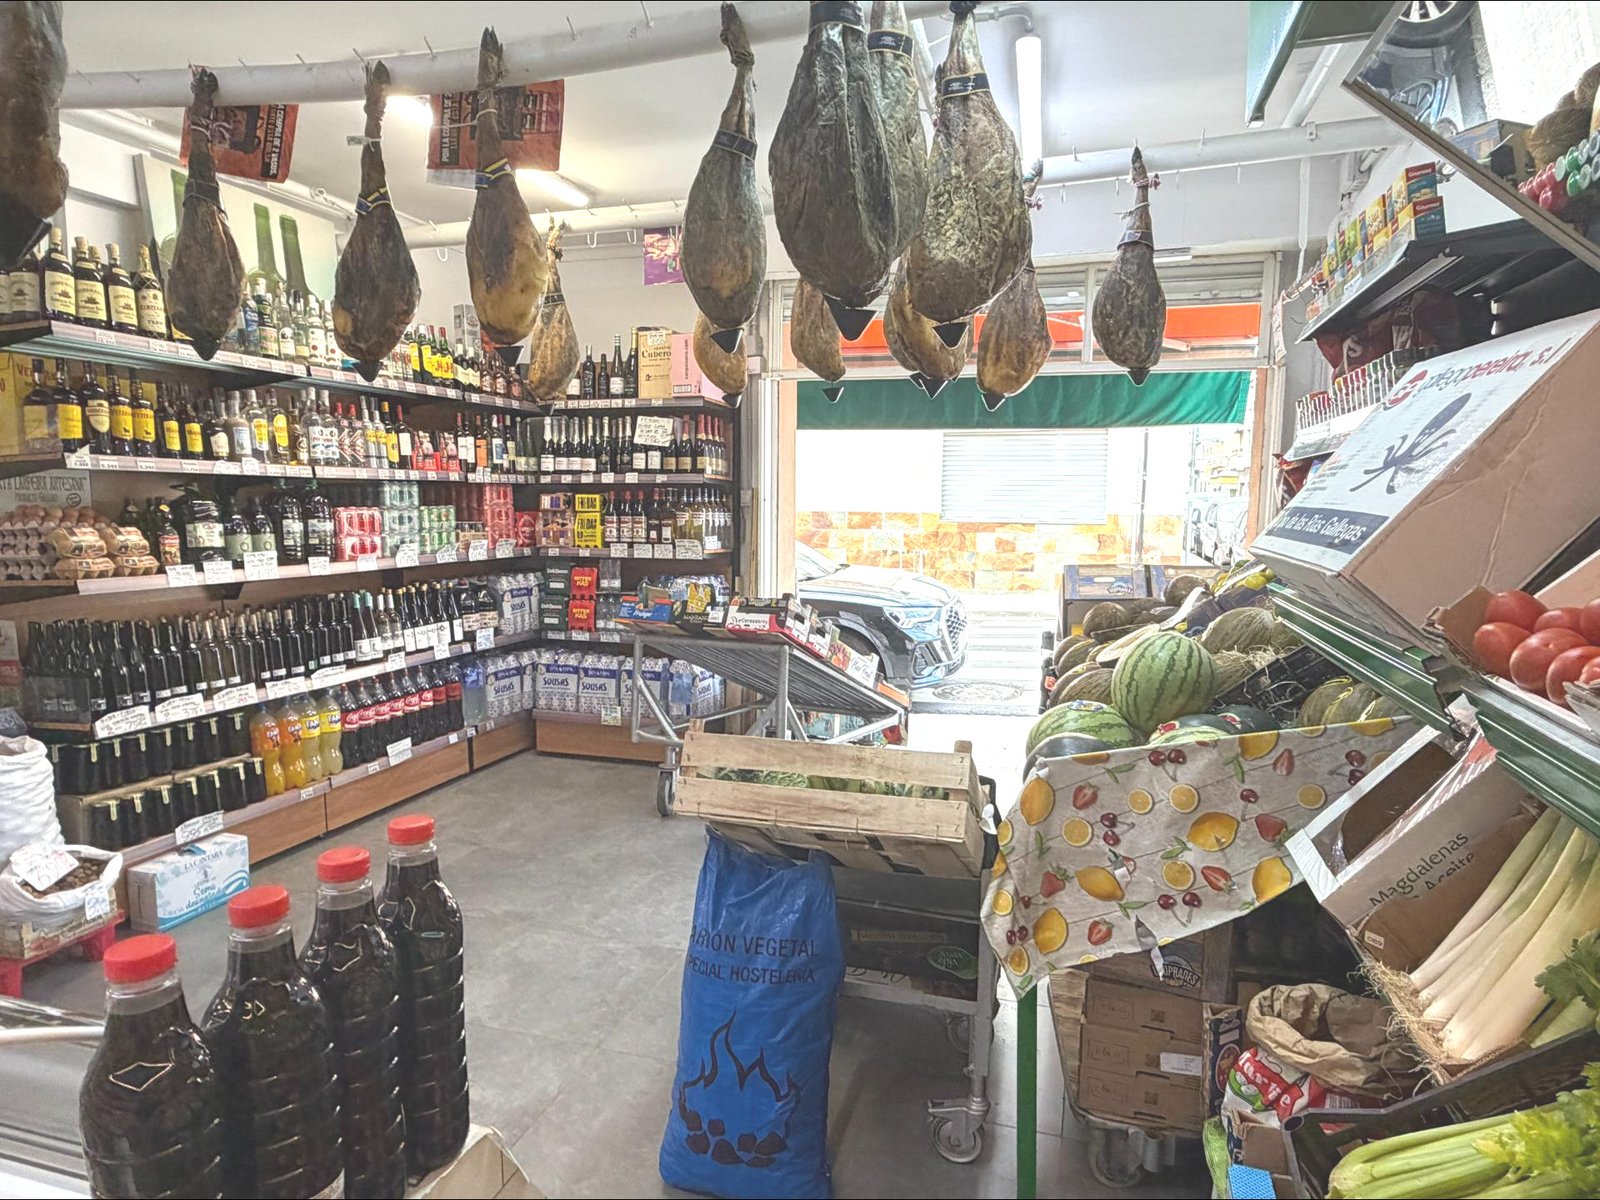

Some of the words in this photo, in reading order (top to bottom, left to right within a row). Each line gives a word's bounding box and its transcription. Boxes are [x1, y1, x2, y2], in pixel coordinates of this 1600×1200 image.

[442, 137, 450, 147] LA
[442, 148, 450, 162] POR
[641, 350, 671, 359] Cubero
[1305, 514, 1324, 534] Rías
[1320, 516, 1367, 544] Gallegas
[543, 677, 569, 687] SOUSAS
[581, 681, 608, 692] SOUSAS
[1369, 833, 1469, 907] Magdalenas
[743, 936, 818, 957] VEGETAL
